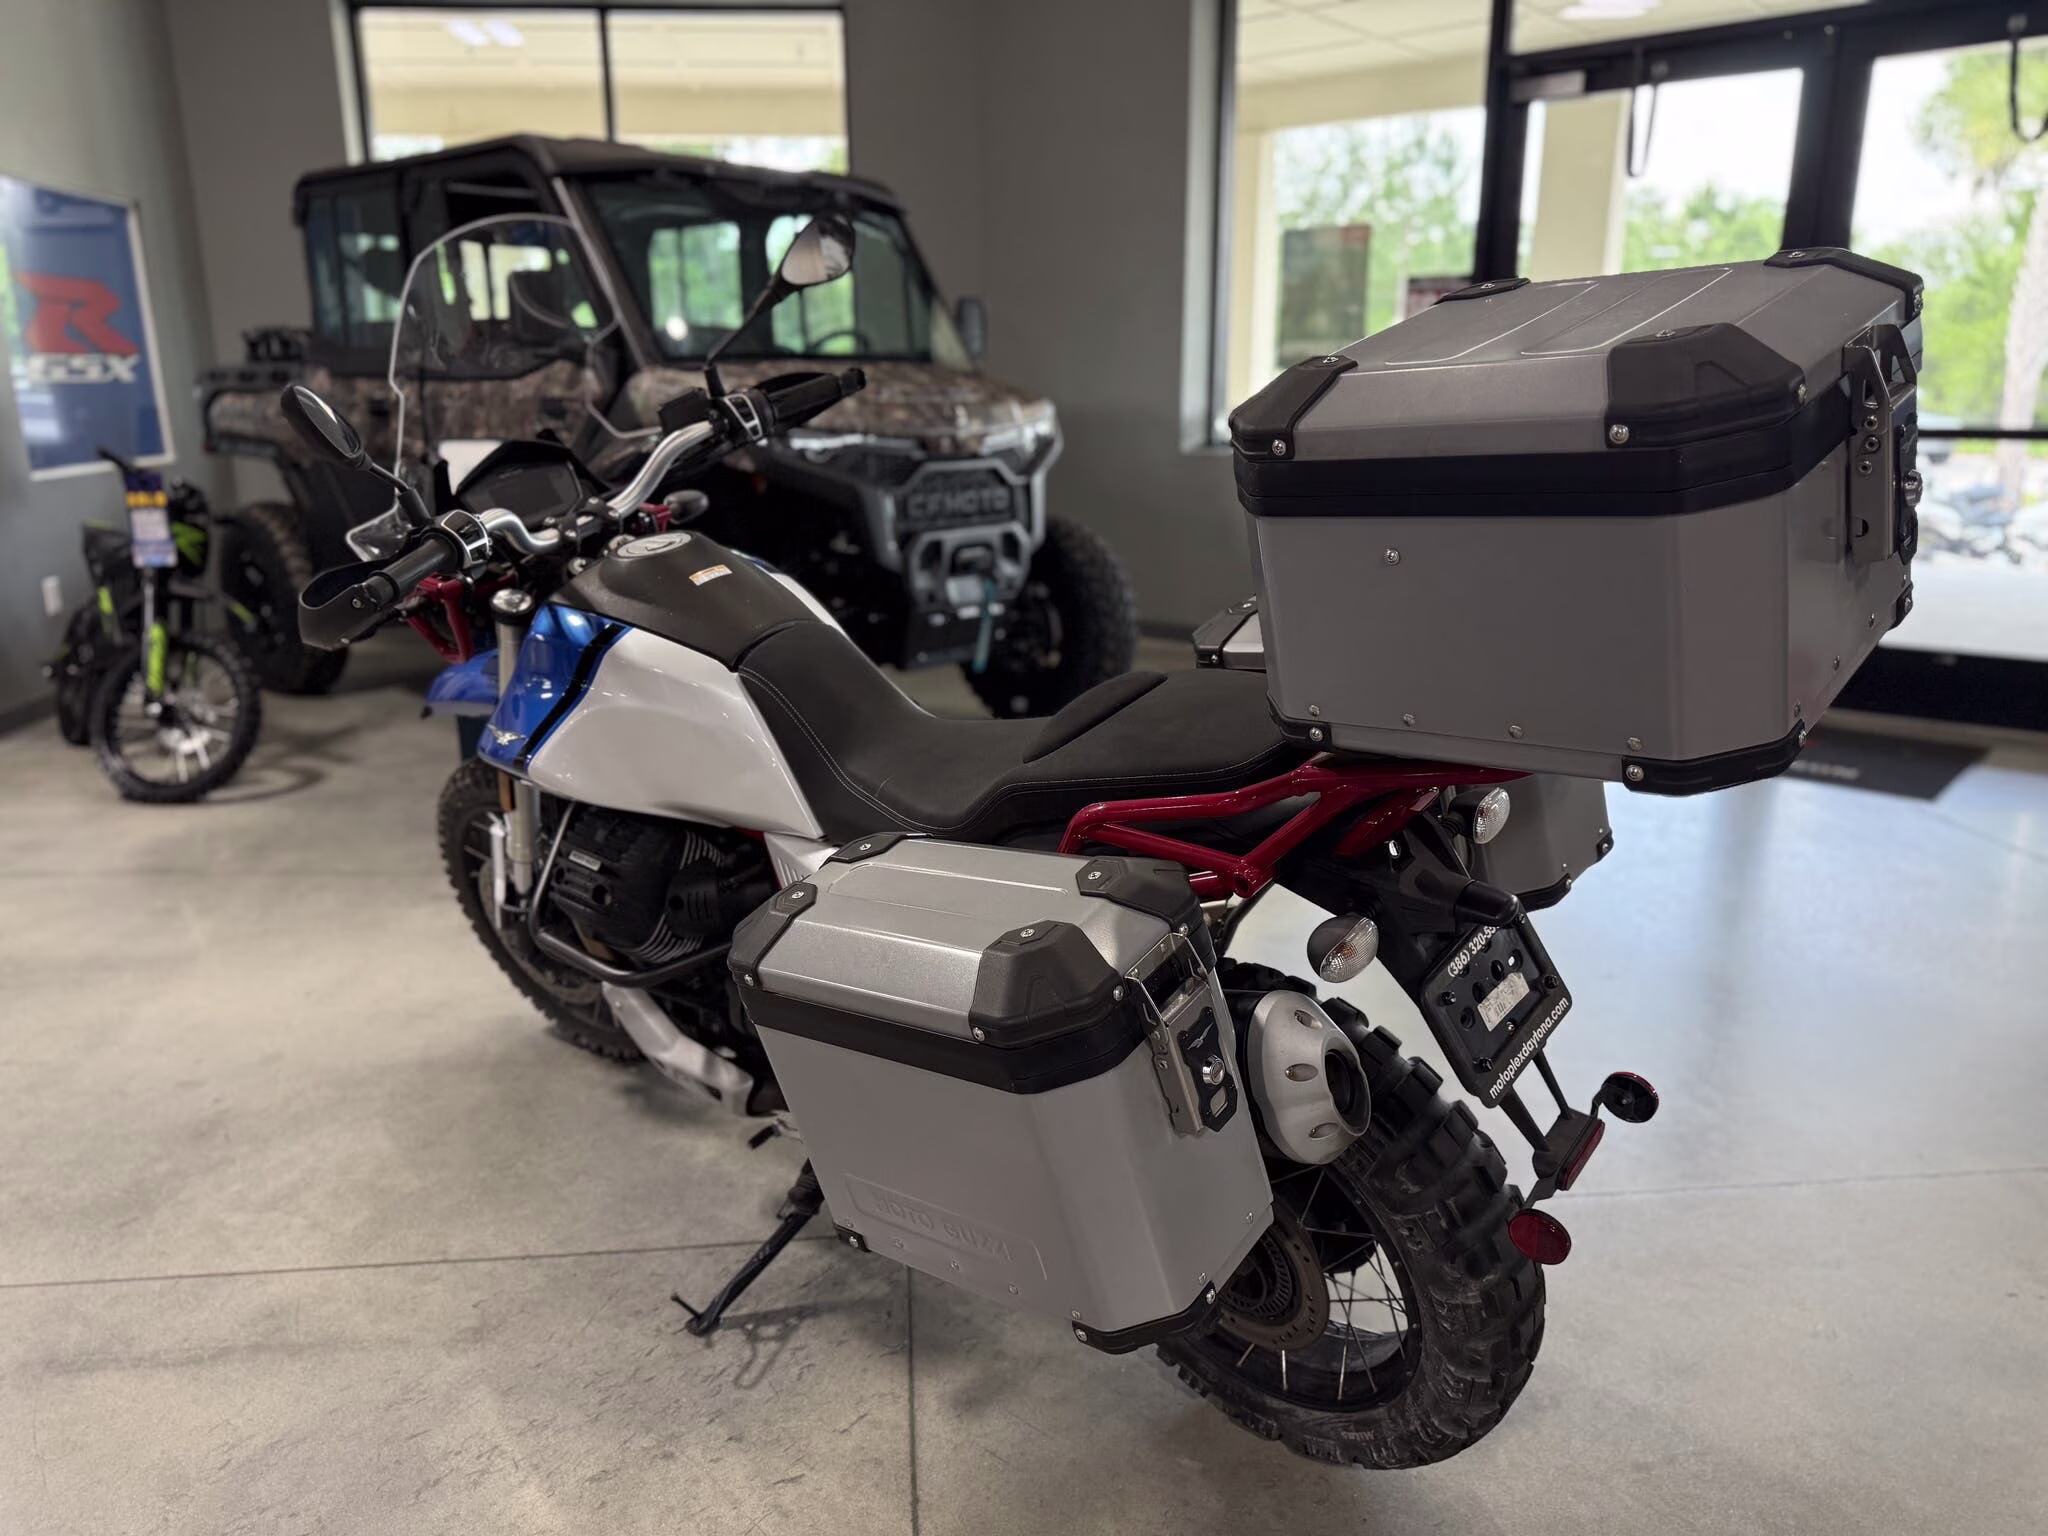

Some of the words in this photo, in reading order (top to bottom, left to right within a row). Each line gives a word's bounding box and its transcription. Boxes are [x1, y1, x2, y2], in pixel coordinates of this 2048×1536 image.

[12, 271, 140, 355] R
[27, 353, 139, 383] GSX
[909, 486, 1010, 518] CFMOTO
[1447, 949, 1471, 978] (386)
[1488, 996, 1569, 1099] motoplexdaytona.com
